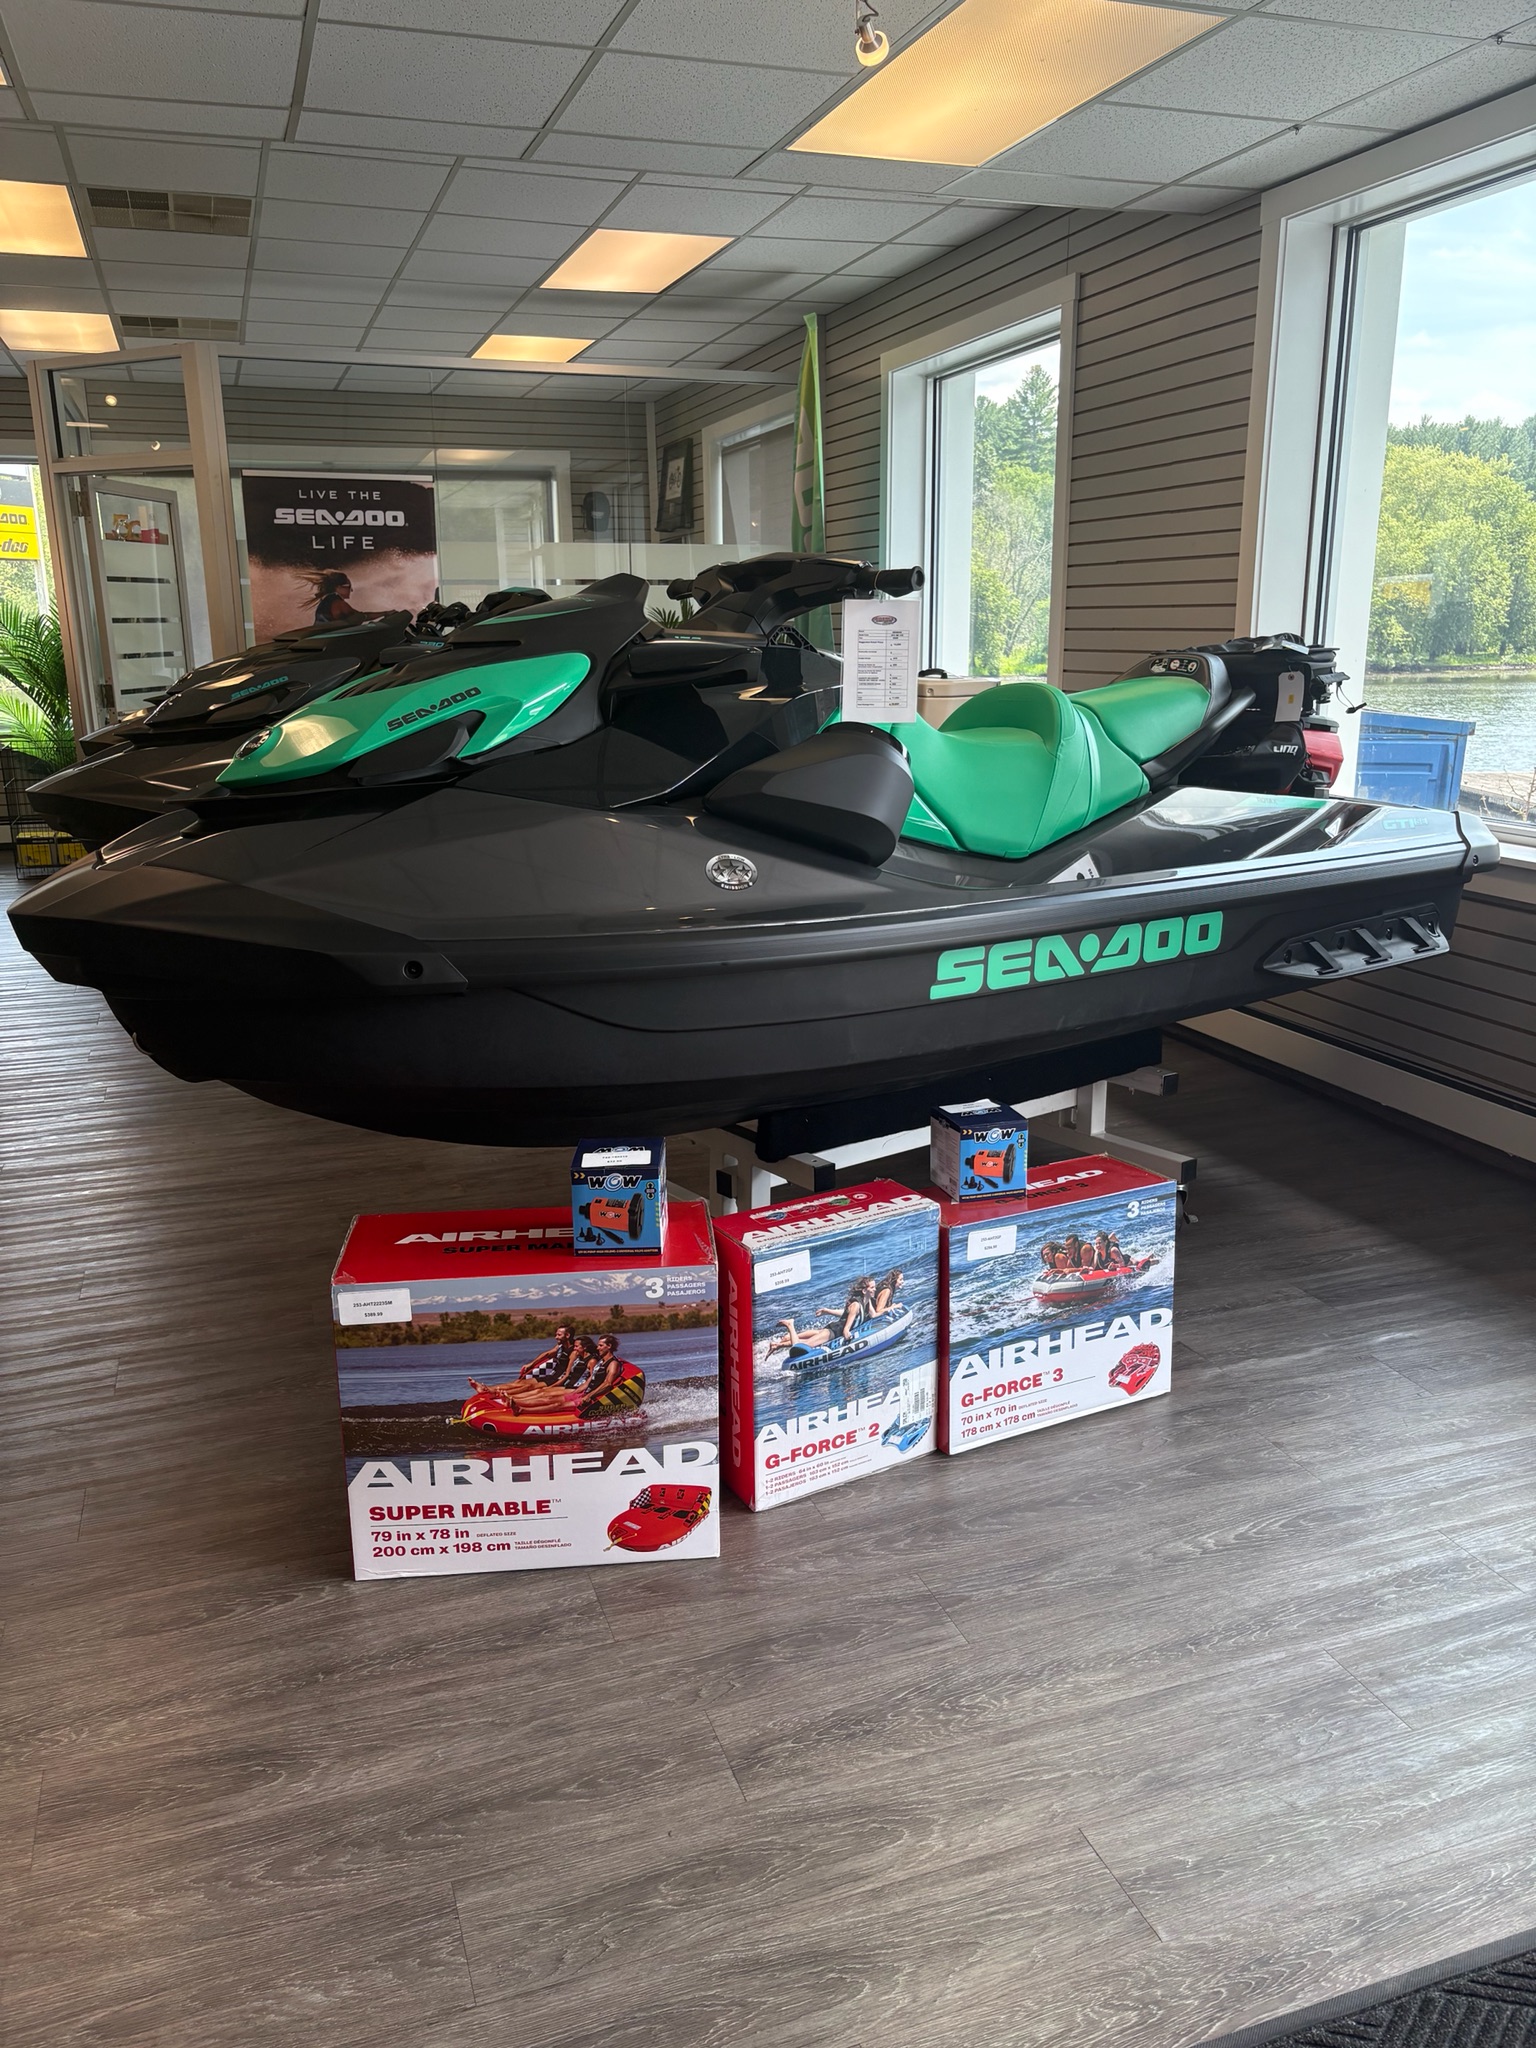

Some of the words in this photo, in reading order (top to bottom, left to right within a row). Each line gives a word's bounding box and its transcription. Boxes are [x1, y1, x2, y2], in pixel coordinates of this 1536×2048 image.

[298, 489, 338, 500] LIVE
[347, 490, 381, 500] THE
[311, 535, 375, 550] LIFE
[974, 1127, 1016, 1145] WOW
[587, 1172, 642, 1192] WOW
[599, 1210, 621, 1219] WOW
[1127, 1200, 1140, 1219] 3
[741, 1194, 923, 1246] AIRHEAD
[442, 1244, 521, 1254] SUPER
[666, 1275, 693, 1283] RIDERS
[645, 1277, 664, 1299] 3
[666, 1281, 706, 1290] PASSAGERS
[666, 1288, 706, 1297] PASAJEROS
[950, 1307, 1173, 1381] AIRHEAD
[789, 1340, 869, 1371] AIRHEAD
[728, 1270, 741, 1468] AIRHEAD
[1053, 1367, 1063, 1383] 3
[961, 1415, 973, 1426] 70
[975, 1413, 984, 1422] in
[985, 1411, 992, 1419] x
[993, 1406, 1006, 1416] 70
[1008, 1403, 1017, 1412] in
[522, 1417, 643, 1435] AIRHEAD
[868, 1422, 880, 1438] 2
[961, 1426, 977, 1438] 178
[980, 1423, 994, 1433] cm
[995, 1421, 1002, 1429] x
[1003, 1415, 1020, 1426] 178
[1021, 1411, 1036, 1421] cm
[348, 1441, 718, 1489] AIRHEAD
[774, 1471, 796, 1482] RIDERS
[774, 1473, 807, 1487] PASSAGERS
[774, 1480, 807, 1493] PASAJEROS
[368, 1503, 456, 1522] SUPER
[371, 1531, 393, 1543] 79
[396, 1530, 412, 1542] in
[415, 1531, 426, 1541] x
[429, 1528, 451, 1540] 78
[454, 1528, 470, 1539] in
[373, 1545, 406, 1558] 200
[410, 1545, 435, 1556] cm
[438, 1544, 449, 1555] x
[452, 1541, 483, 1554] 198
[486, 1541, 511, 1552] cm
